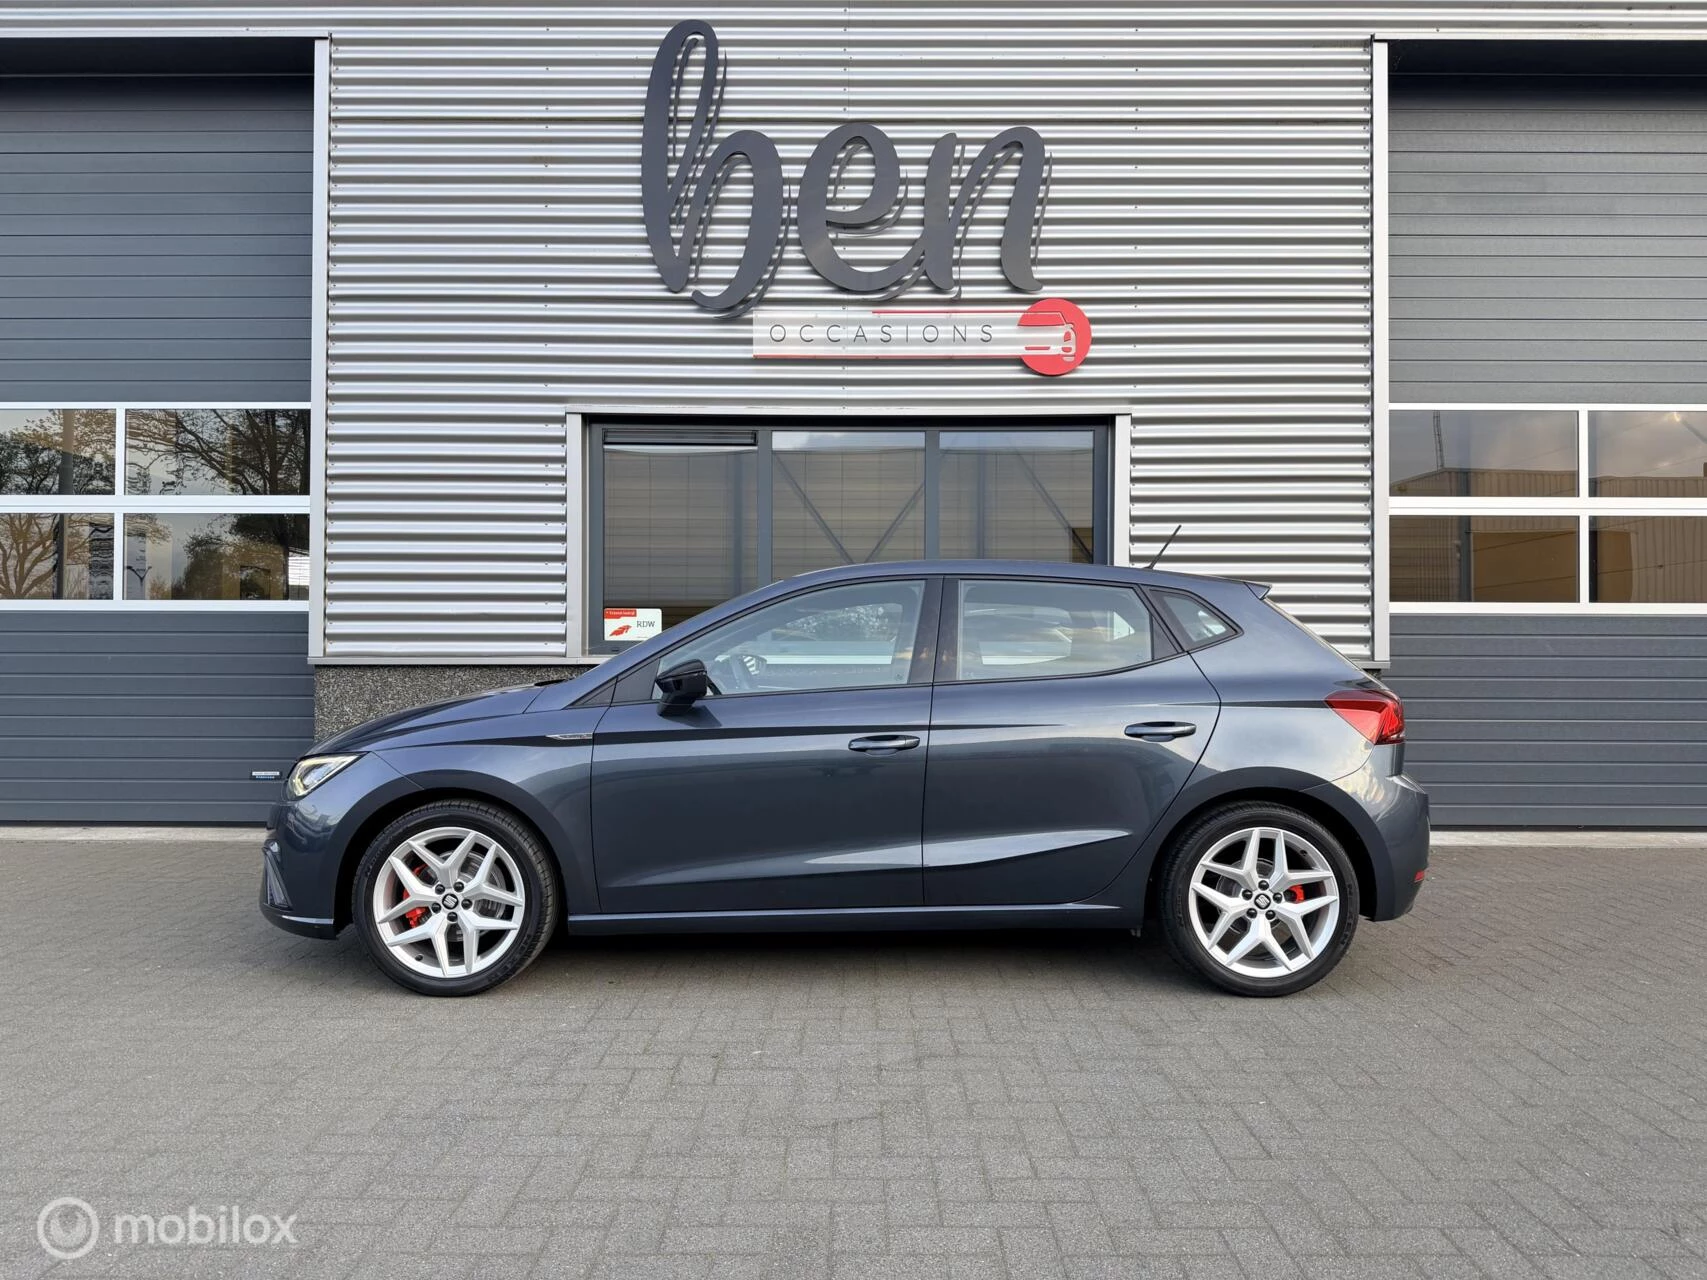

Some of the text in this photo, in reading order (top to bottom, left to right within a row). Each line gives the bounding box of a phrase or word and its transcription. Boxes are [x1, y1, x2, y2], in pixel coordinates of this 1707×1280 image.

[641, 19, 1045, 310] ben
[769, 323, 994, 344] OCCASIONS
[636, 620, 656, 628] RDW
